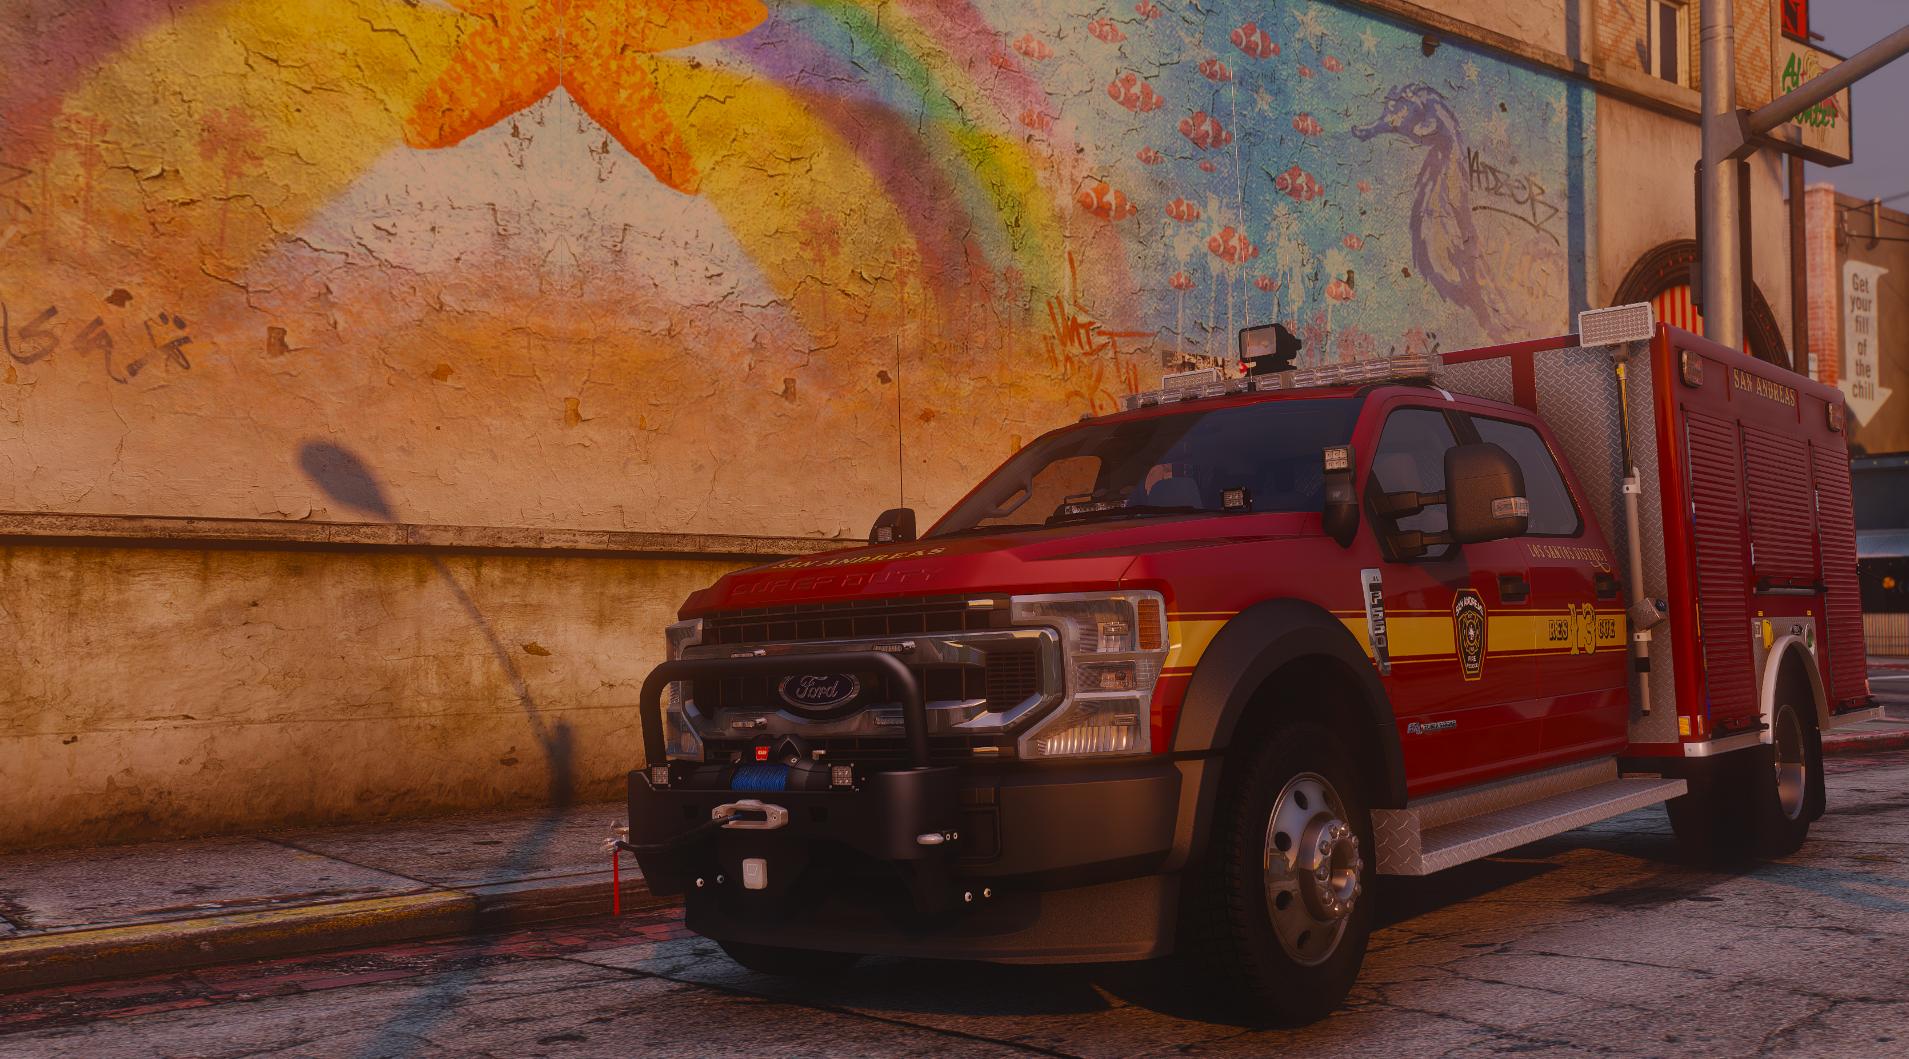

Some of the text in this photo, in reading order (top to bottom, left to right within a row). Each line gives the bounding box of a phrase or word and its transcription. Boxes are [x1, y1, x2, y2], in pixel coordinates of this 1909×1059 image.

[1852, 273, 1869, 294] Get
[1850, 295, 1872, 313] your
[1855, 315, 1869, 335] fill
[1857, 338, 1868, 356] of
[1856, 360, 1871, 379] the
[1733, 368, 1796, 407] SAN ANDREAS
[1852, 381, 1874, 400] chill
[815, 547, 946, 567] ANDREAS
[796, 675, 839, 700] Ford
